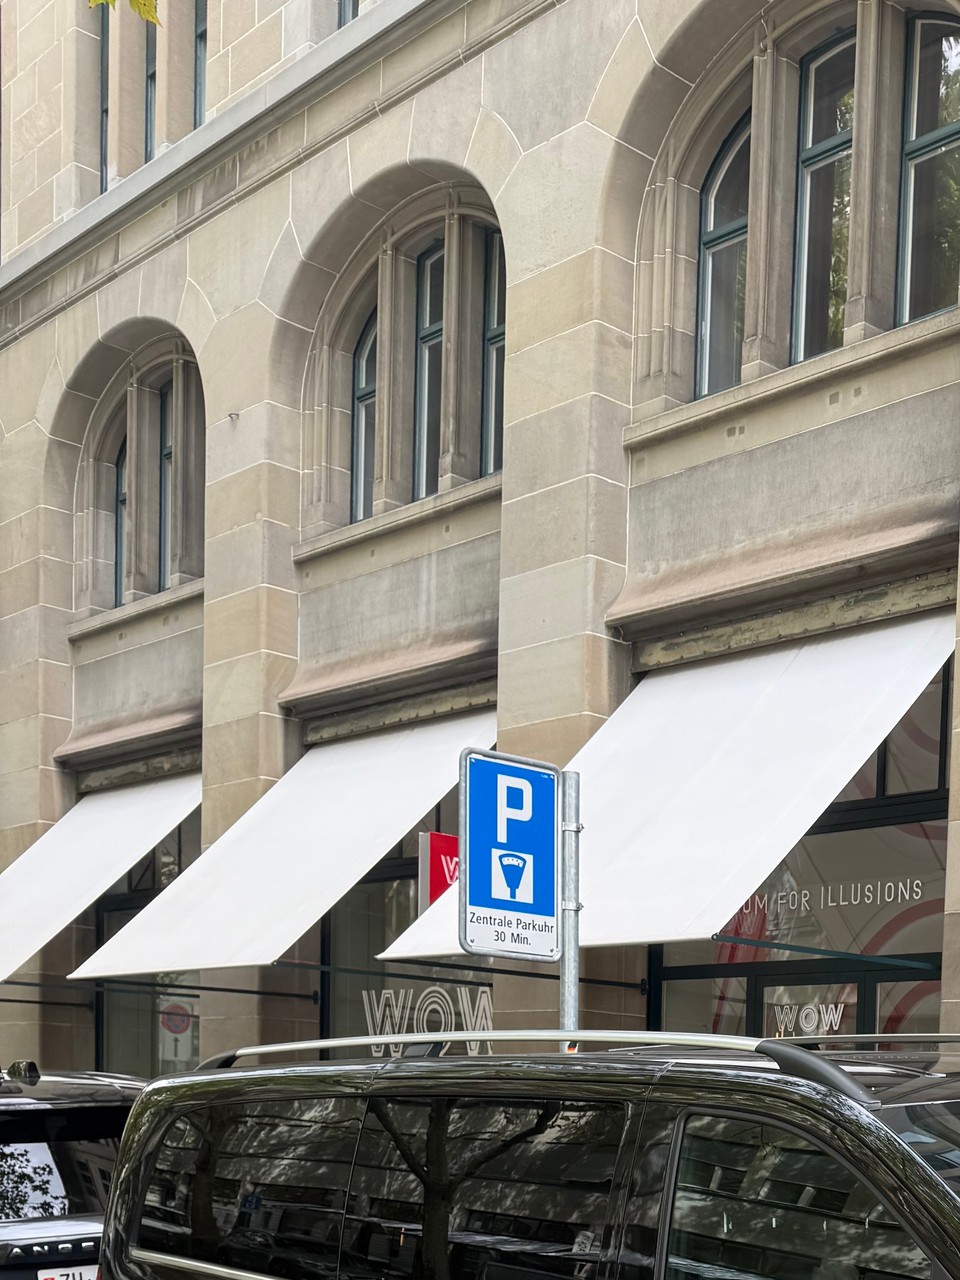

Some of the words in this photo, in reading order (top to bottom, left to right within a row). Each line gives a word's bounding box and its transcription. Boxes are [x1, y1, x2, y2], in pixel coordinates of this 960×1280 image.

[497, 774, 533, 843] P
[743, 894, 768, 914] UM
[777, 890, 810, 913] FOR
[820, 878, 922, 909] ILLUSIONS
[469, 911, 513, 929] Zentrale
[516, 918, 555, 934] Parkuhr
[493, 930, 506, 942] 30
[510, 932, 531, 945] Min.
[362, 986, 493, 1057] WOW
[774, 1003, 845, 1032] WOW
